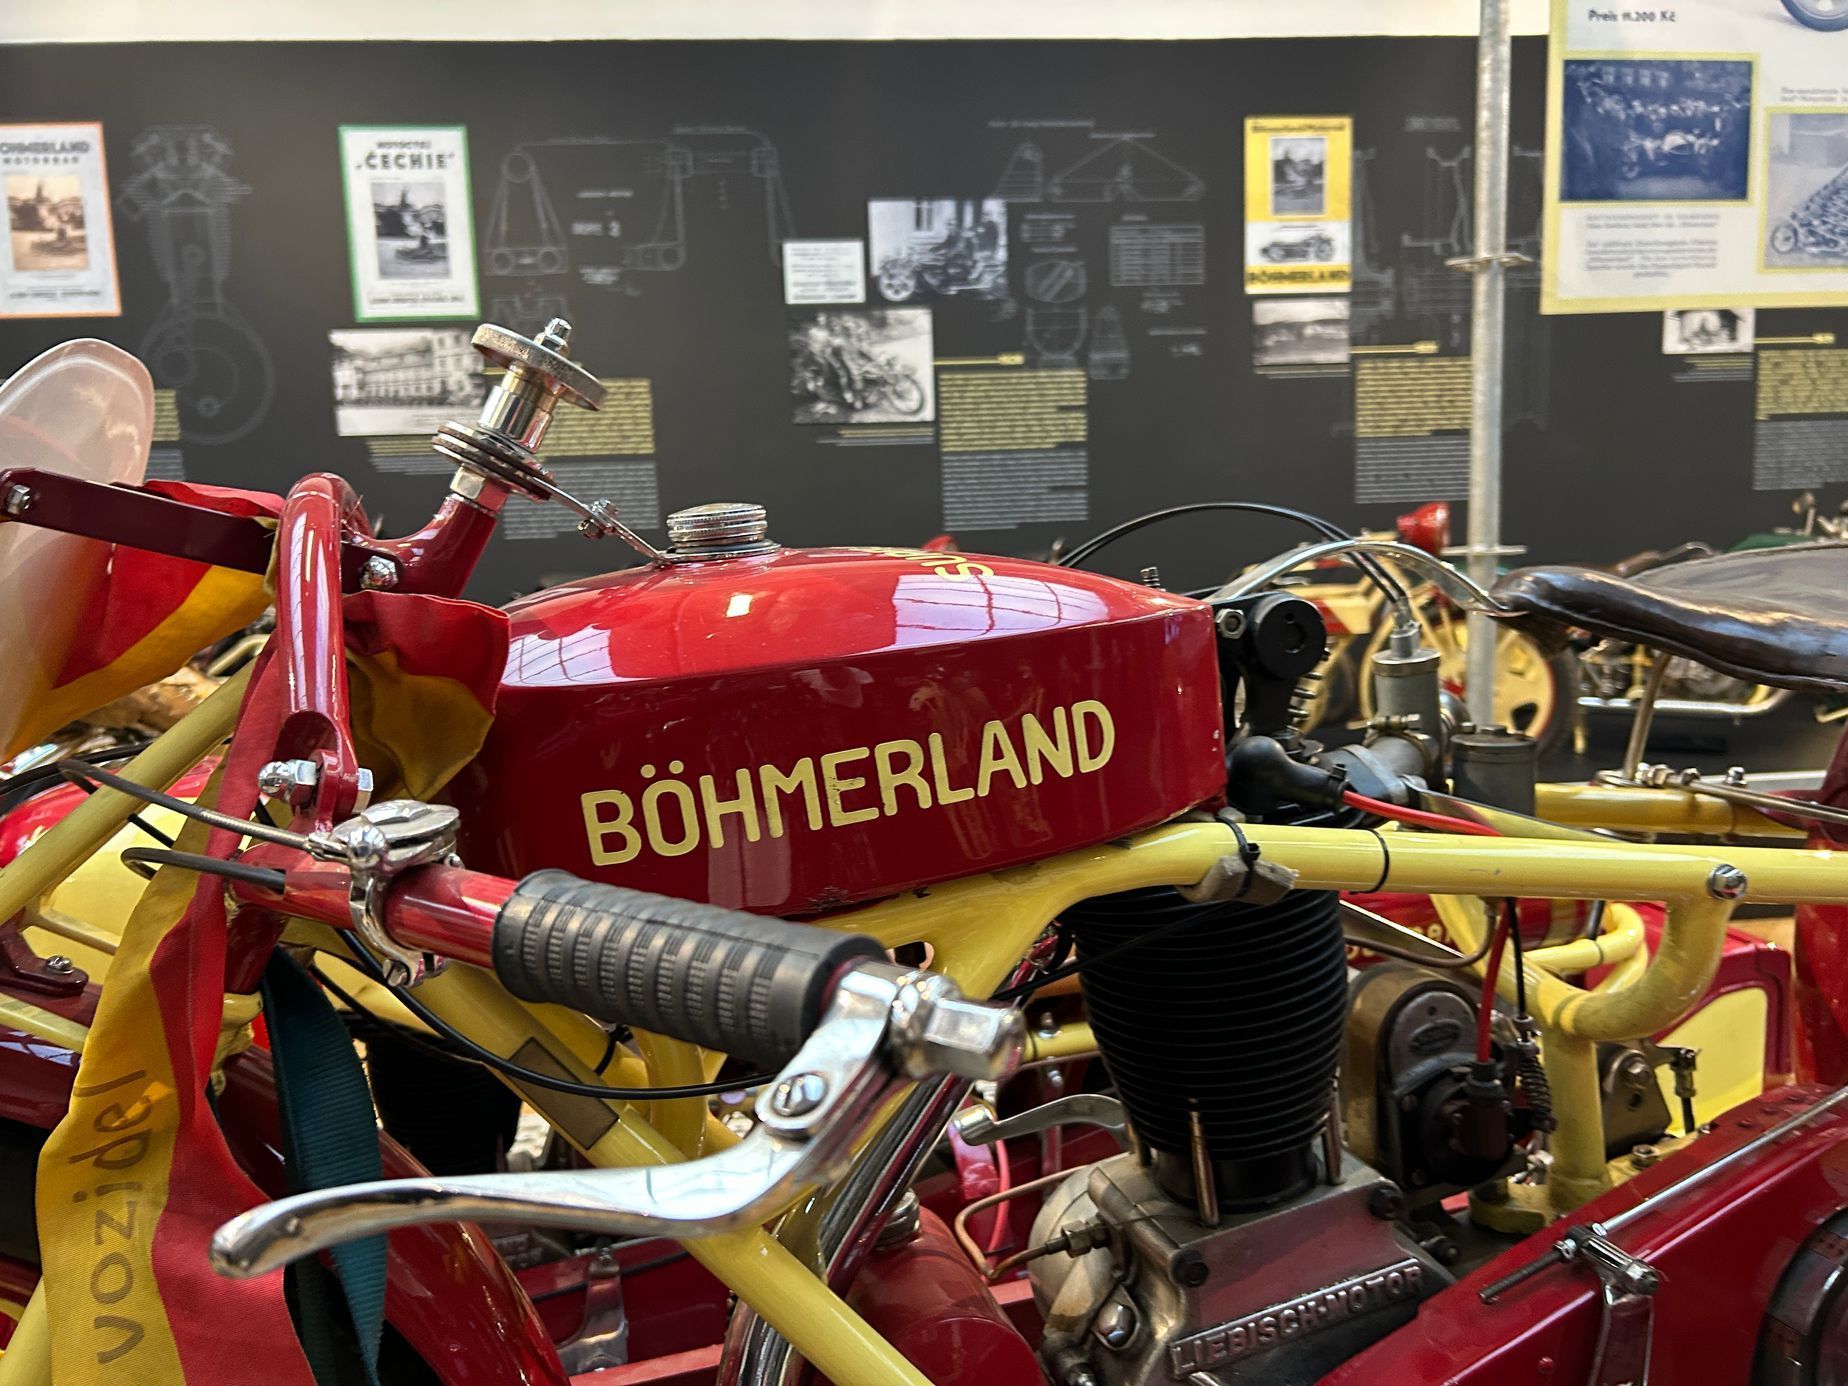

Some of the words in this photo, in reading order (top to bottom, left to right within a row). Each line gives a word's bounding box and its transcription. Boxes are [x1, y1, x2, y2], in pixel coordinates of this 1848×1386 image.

[1588, 10, 1618, 22] Preis
[580, 699, 1116, 867] BÖHMERLAND
[67, 1069, 153, 1365] vozidel
